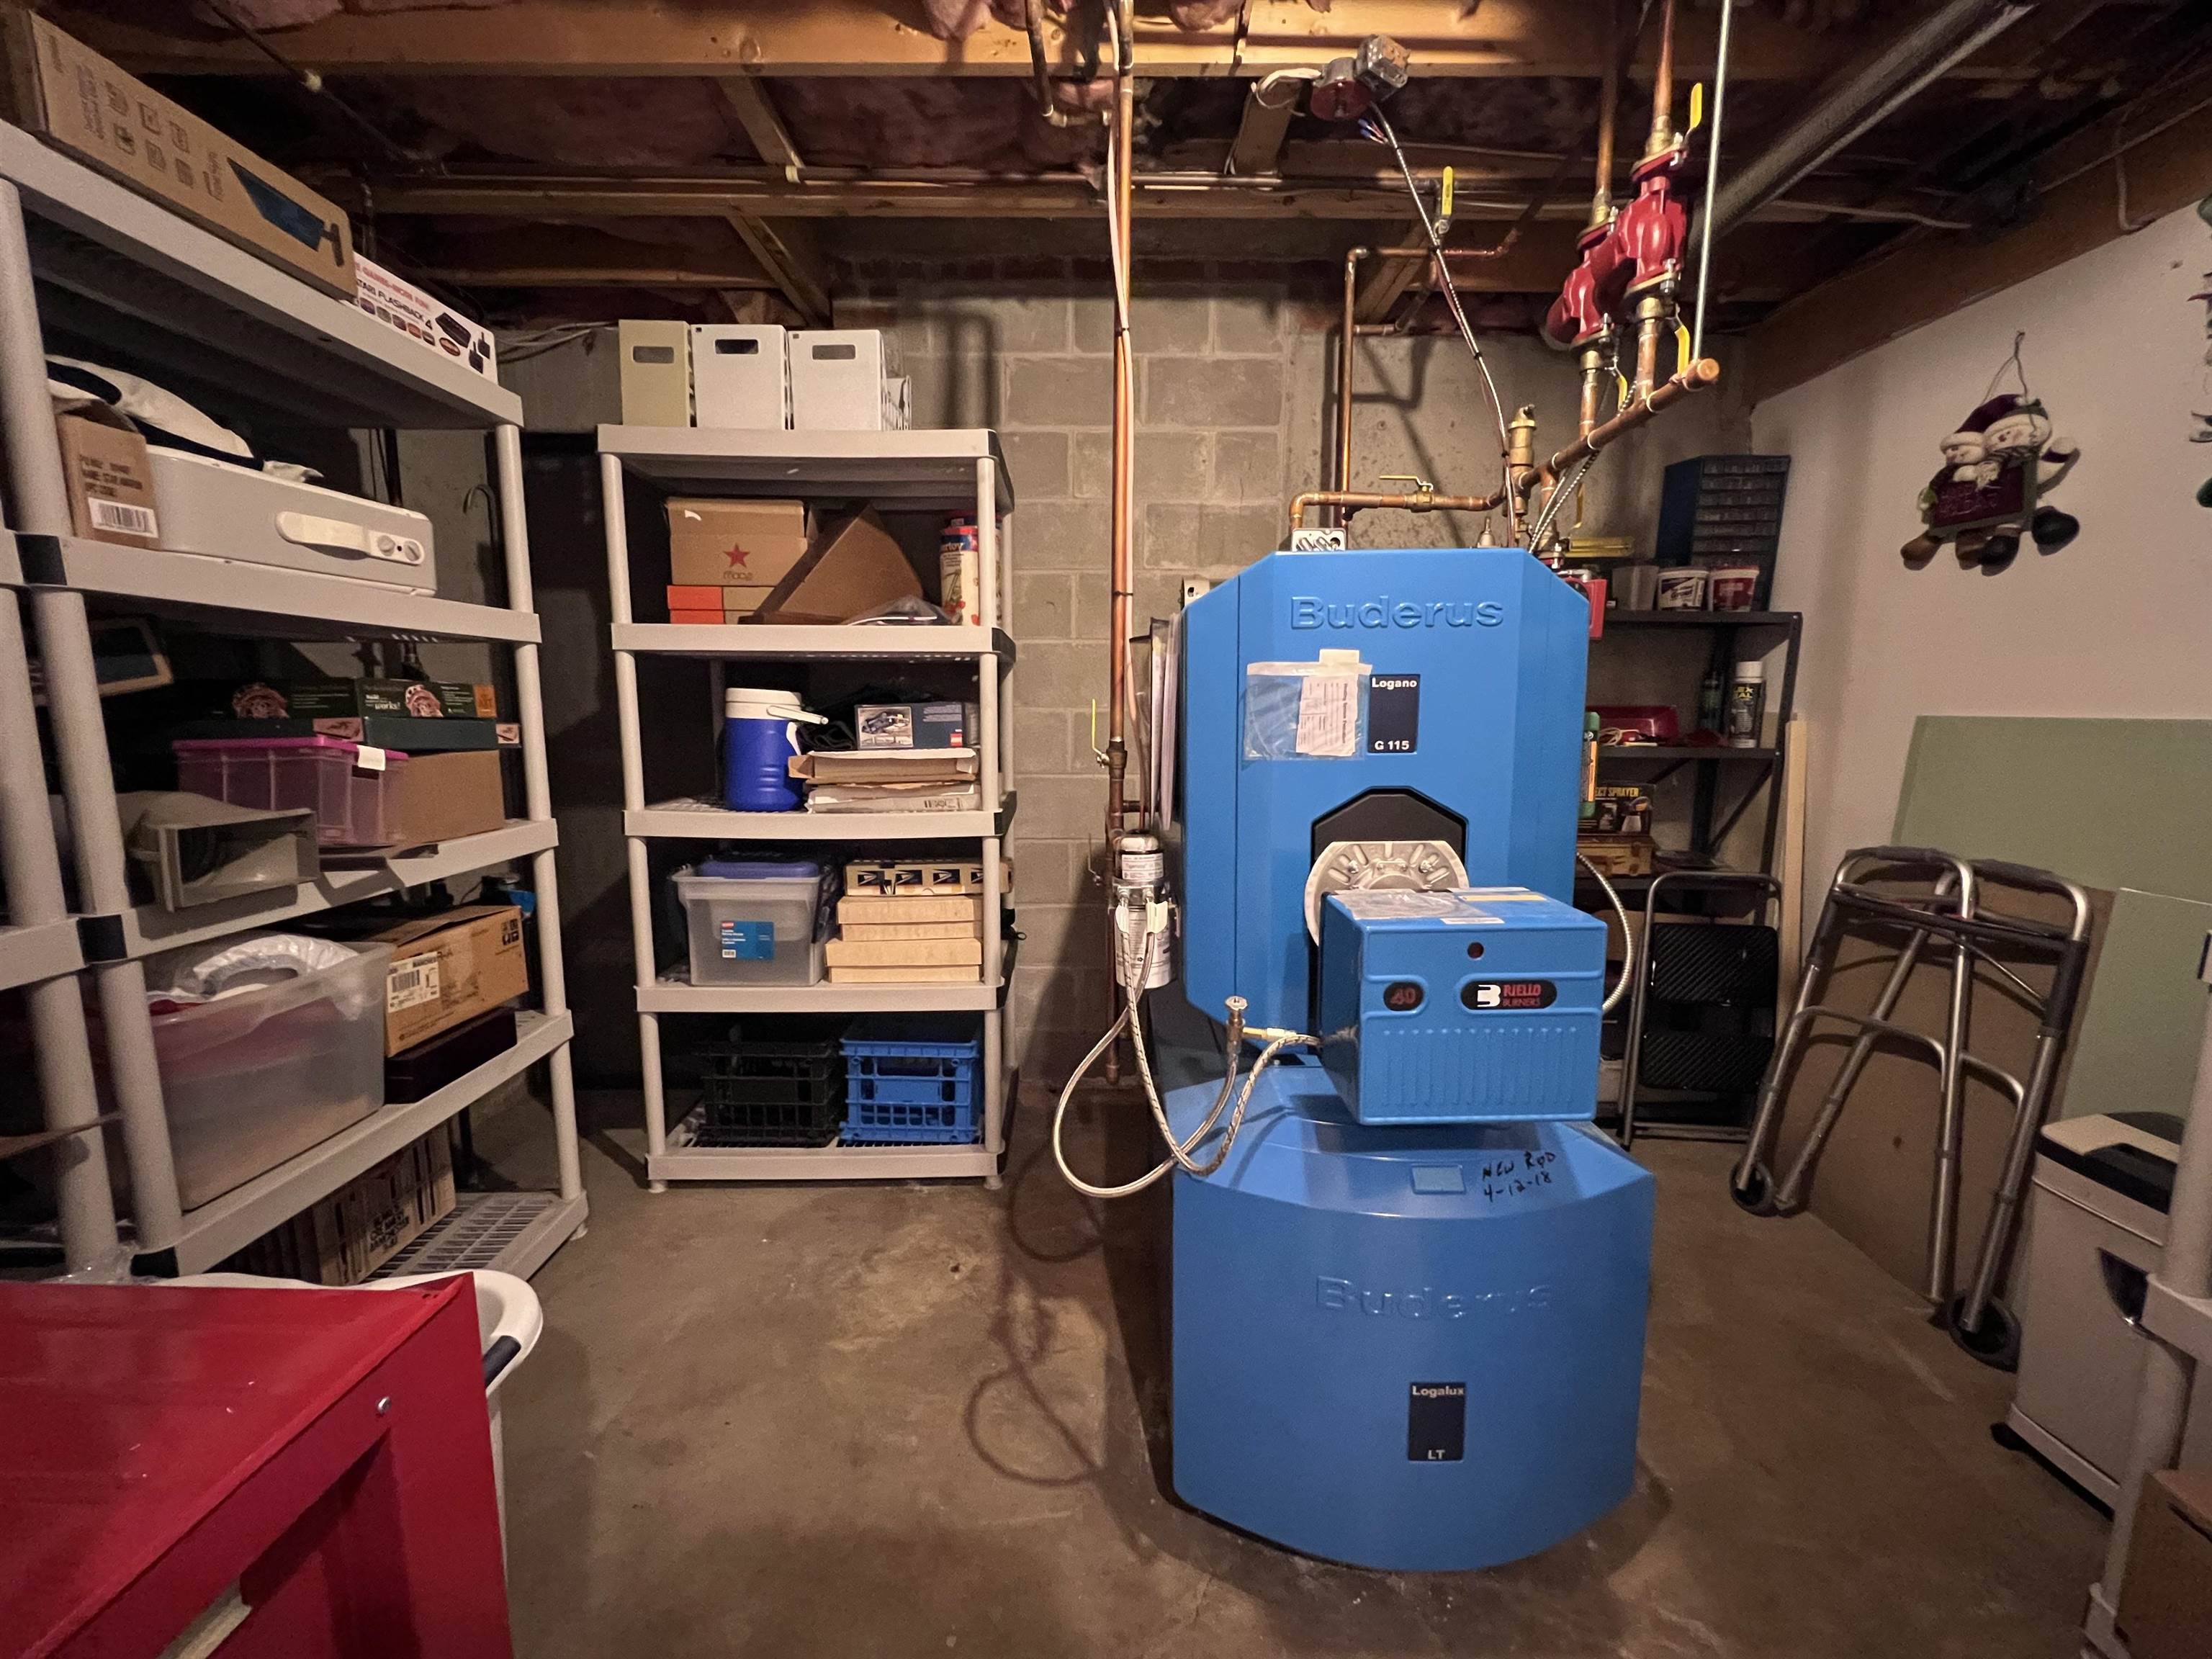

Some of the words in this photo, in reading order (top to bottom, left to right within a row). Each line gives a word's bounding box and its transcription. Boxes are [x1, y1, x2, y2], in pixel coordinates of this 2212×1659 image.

[356, 278, 376, 296] TARI
[1291, 595, 1503, 629] Buderus
[1372, 678, 1417, 690] Logano
[1375, 740, 1384, 750] G
[1388, 740, 1409, 750] 115
[1608, 787, 1639, 797] SPRAYER
[1503, 984, 1542, 997] RIELLO
[1503, 997, 1541, 1007] BURNERS
[1483, 1161, 1514, 1182] NEW
[1483, 1171, 1552, 1202] 4-12-18
[1412, 1385, 1464, 1398] Logalux
[1427, 1449, 1445, 1460] LT
